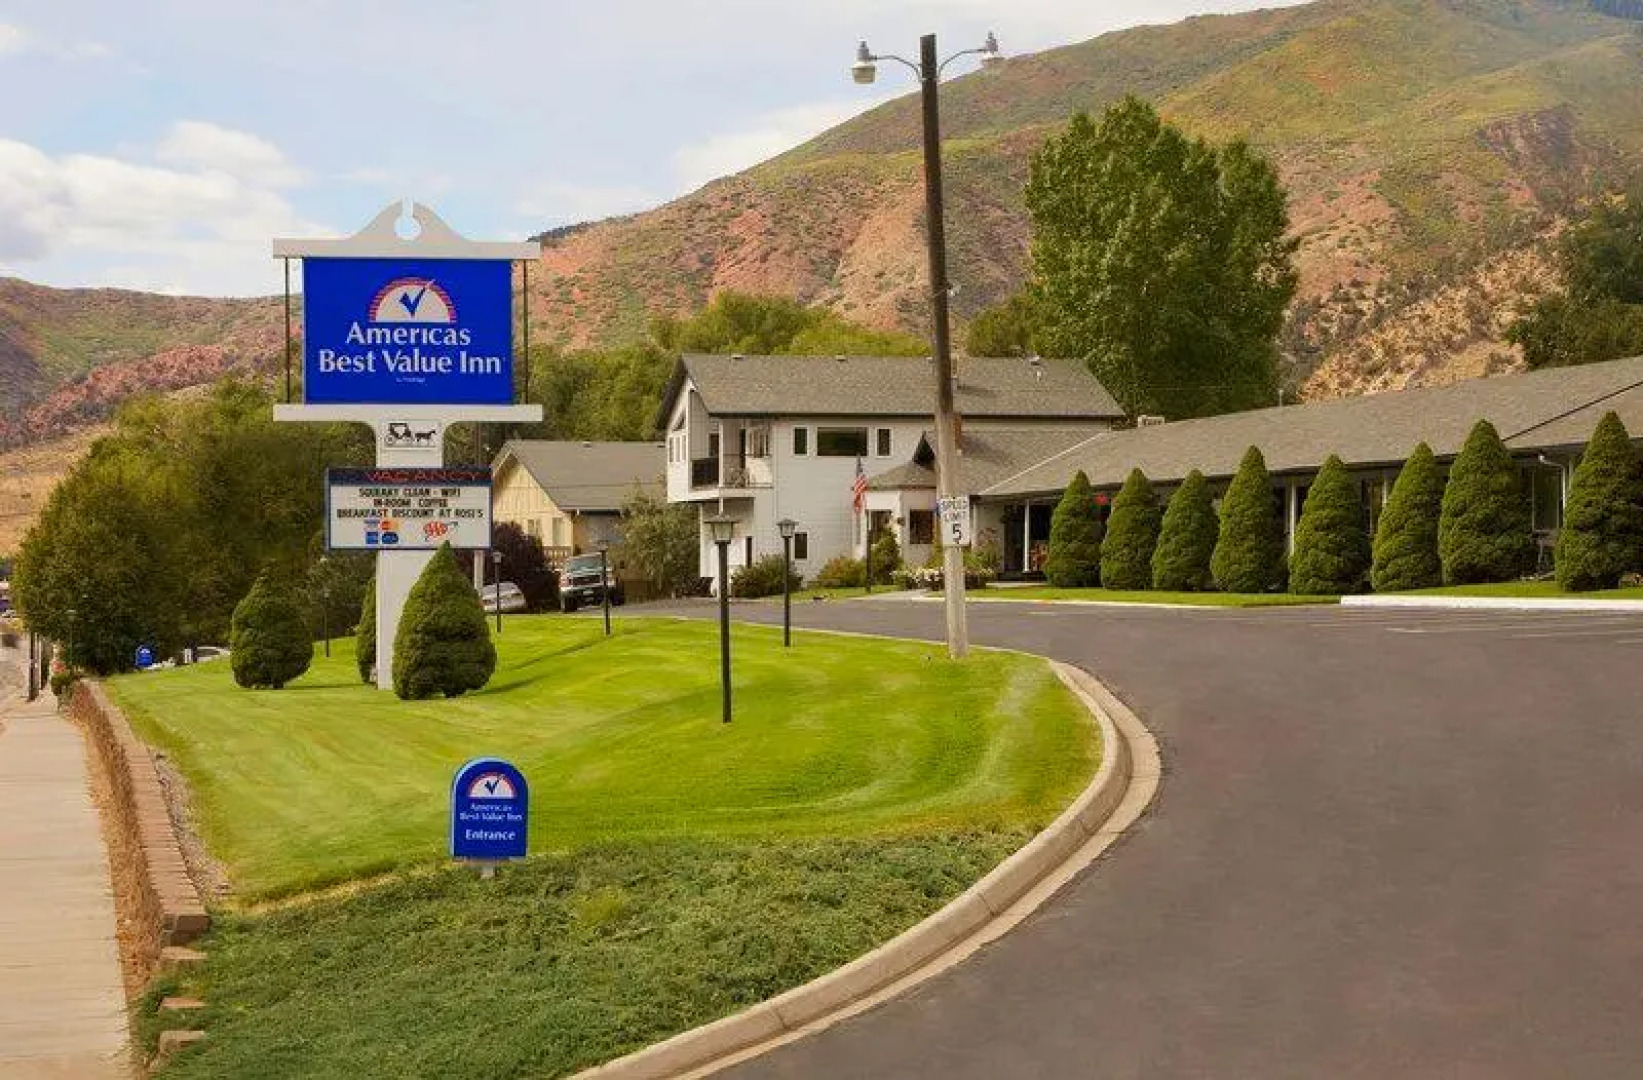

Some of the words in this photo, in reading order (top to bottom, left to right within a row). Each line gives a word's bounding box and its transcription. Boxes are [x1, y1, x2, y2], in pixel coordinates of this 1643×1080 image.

[345, 322, 471, 345] Americas
[319, 349, 376, 373] Best
[382, 348, 452, 373] Value
[460, 350, 500, 373] Inn
[403, 488, 430, 498] CLEAN
[419, 498, 448, 508] COFFEE
[336, 508, 388, 518] BREAKFAST
[392, 508, 434, 518] DISCOUNT
[439, 508, 451, 518] AT
[952, 523, 962, 541] 5
[465, 829, 516, 841] Entrance
